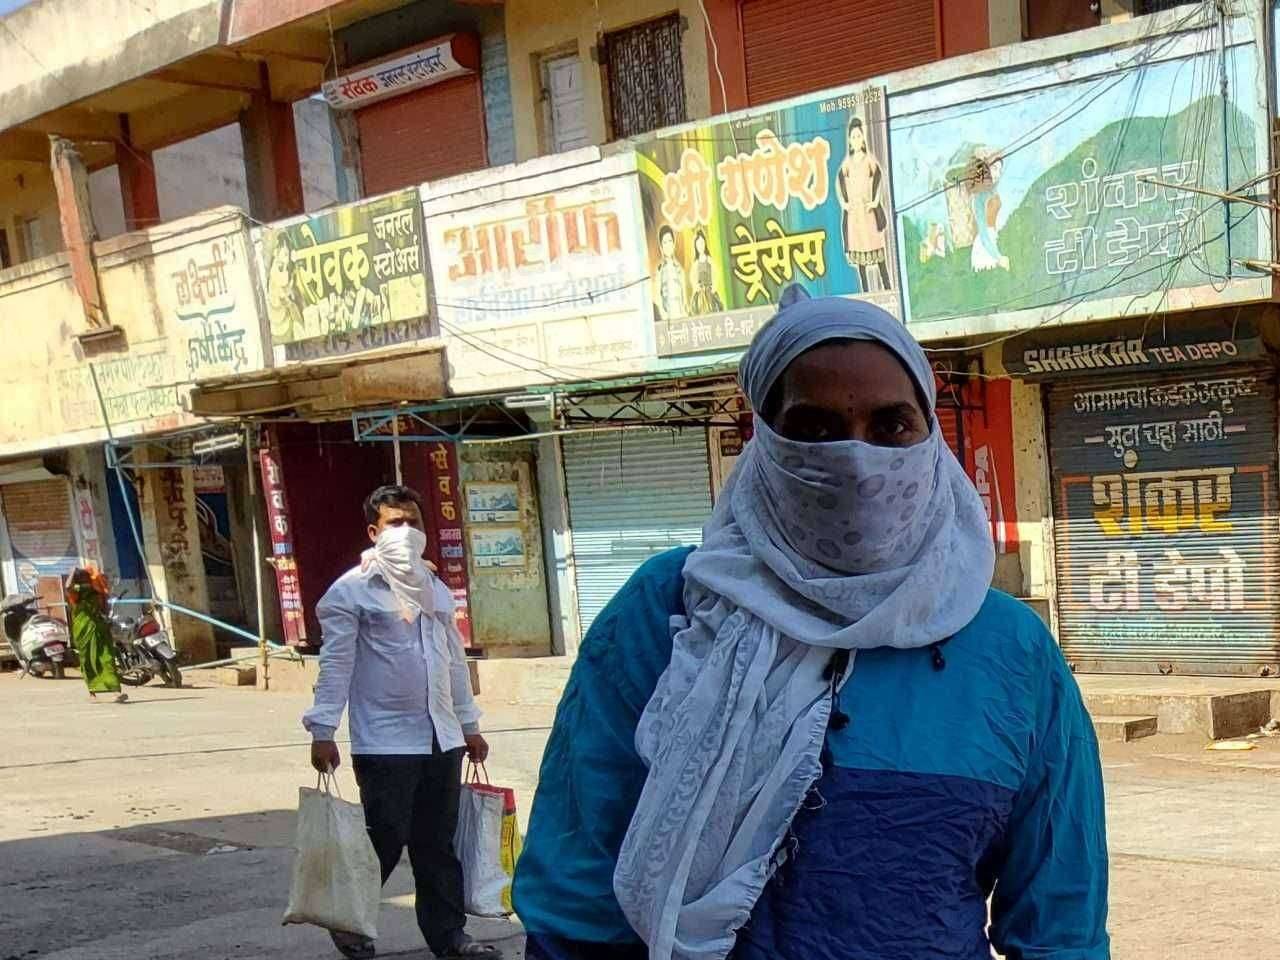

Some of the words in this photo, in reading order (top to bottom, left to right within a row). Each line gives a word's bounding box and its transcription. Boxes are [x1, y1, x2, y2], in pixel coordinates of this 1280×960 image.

[662, 148, 714, 232] श्री
[716, 129, 830, 217] गणेश
[1046, 157, 1200, 220] शंकर
[372, 208, 414, 241] जनरल
[443, 194, 622, 282] आरीफ
[730, 218, 826, 303] ड्रेसेस
[1044, 226, 1098, 274] टी
[291, 223, 370, 305] सेवक
[1023, 339, 1149, 374] SHANKAR
[1149, 346, 1187, 363] TEA
[1186, 340, 1238, 362] DEPO
[1091, 449, 1236, 536] शंकर
[1088, 551, 1142, 610] टी
